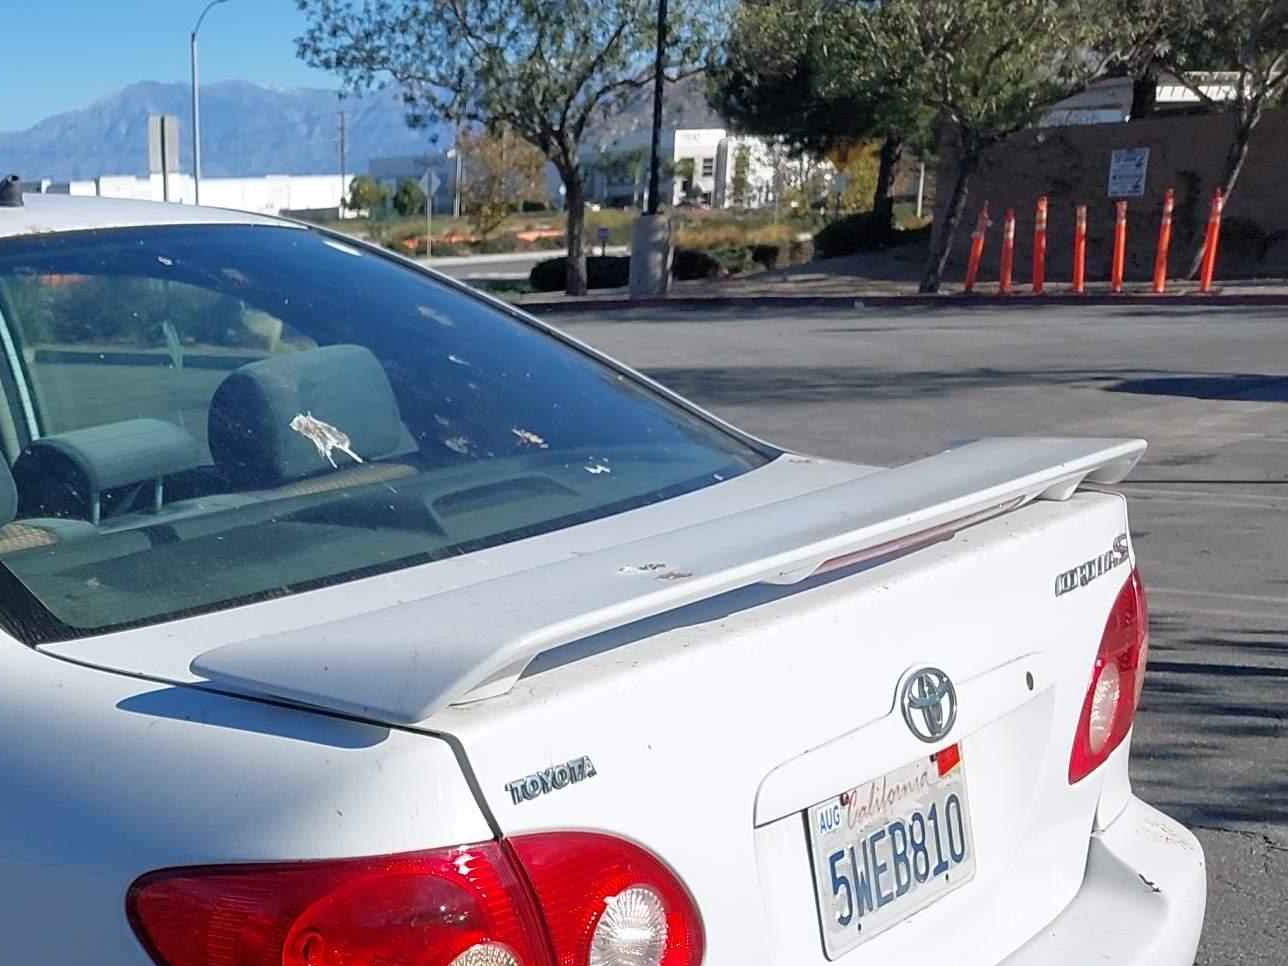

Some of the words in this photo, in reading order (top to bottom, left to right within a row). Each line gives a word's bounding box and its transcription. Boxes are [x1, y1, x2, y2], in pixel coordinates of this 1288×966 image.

[505, 755, 597, 805] TOYOTA
[846, 772, 931, 829] California
[819, 806, 840, 834] AUG
[829, 793, 965, 927] 5WEB810
